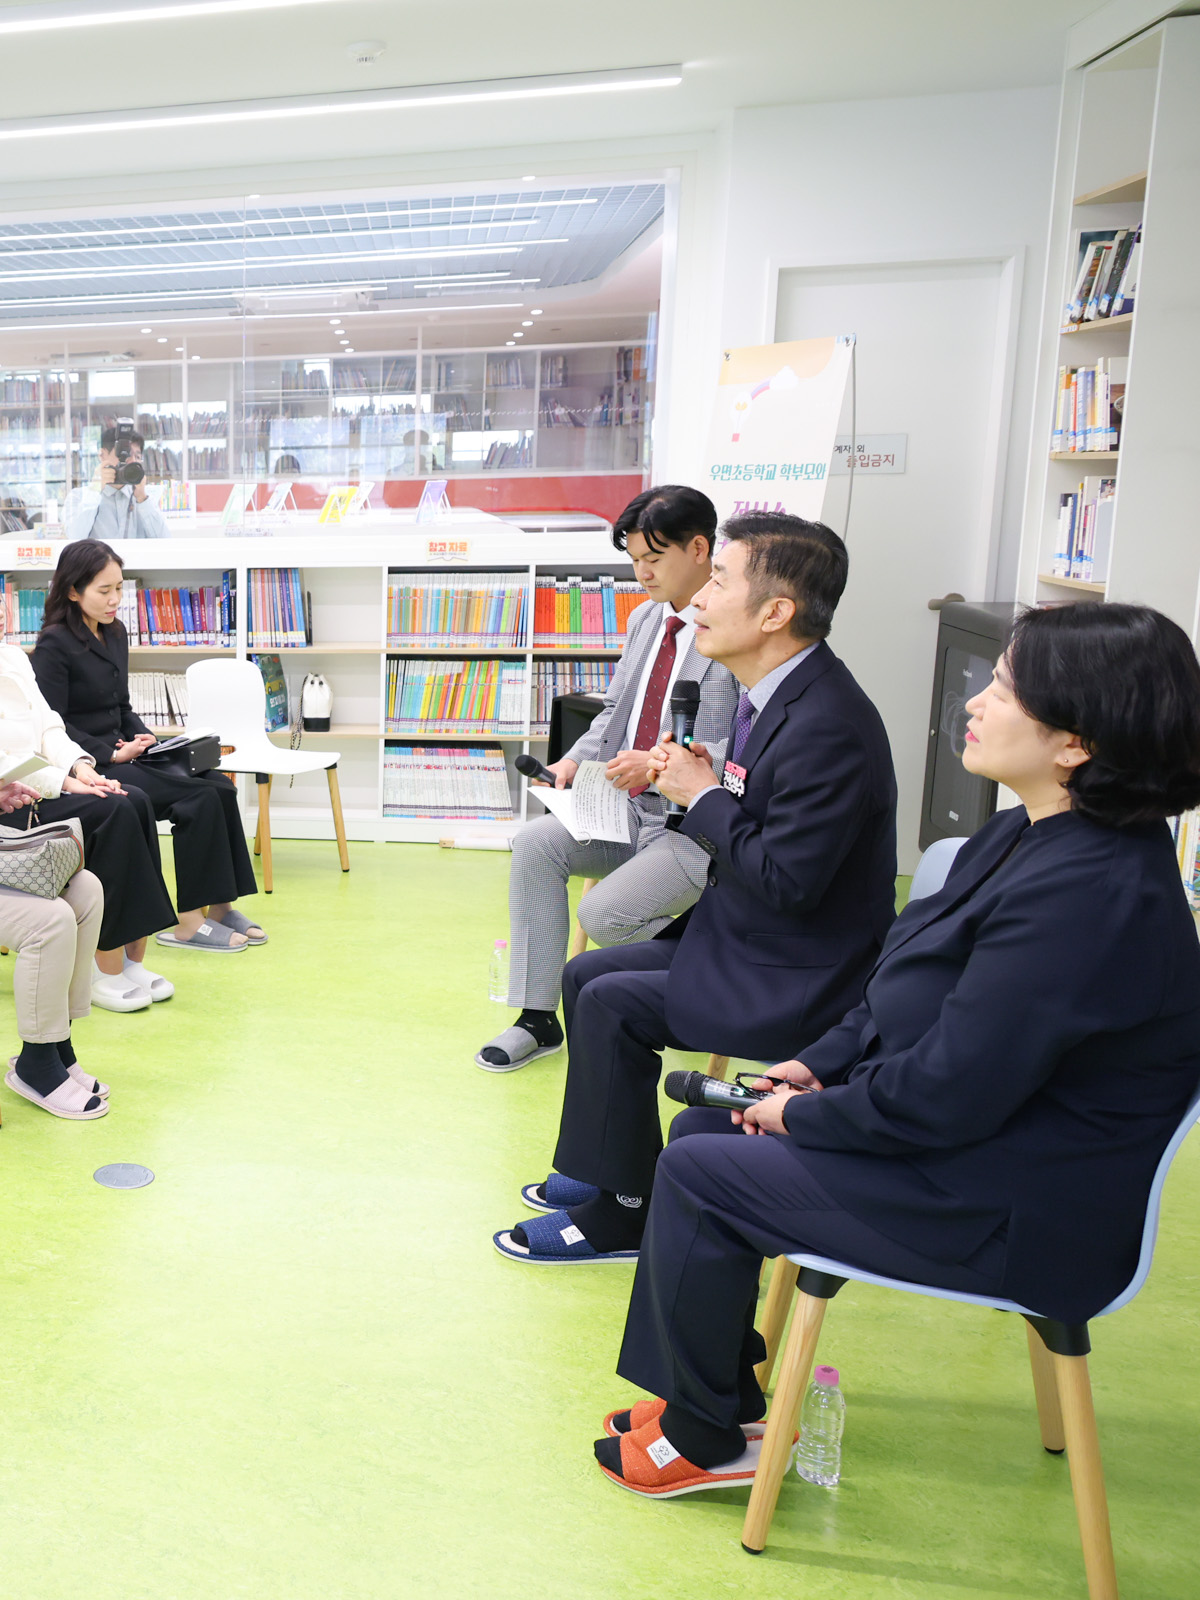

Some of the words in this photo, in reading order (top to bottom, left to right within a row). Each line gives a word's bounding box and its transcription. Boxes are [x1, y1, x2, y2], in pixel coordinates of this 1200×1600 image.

[833, 444, 852, 454] 계자
[856, 444, 866, 453] 외
[709, 463, 777, 481] 우면초등학교
[779, 462, 827, 480] 학부모와
[428, 541, 447, 552] 참고
[448, 541, 468, 552] 자료
[17, 547, 33, 557] 참고
[34, 547, 52, 557] 자료
